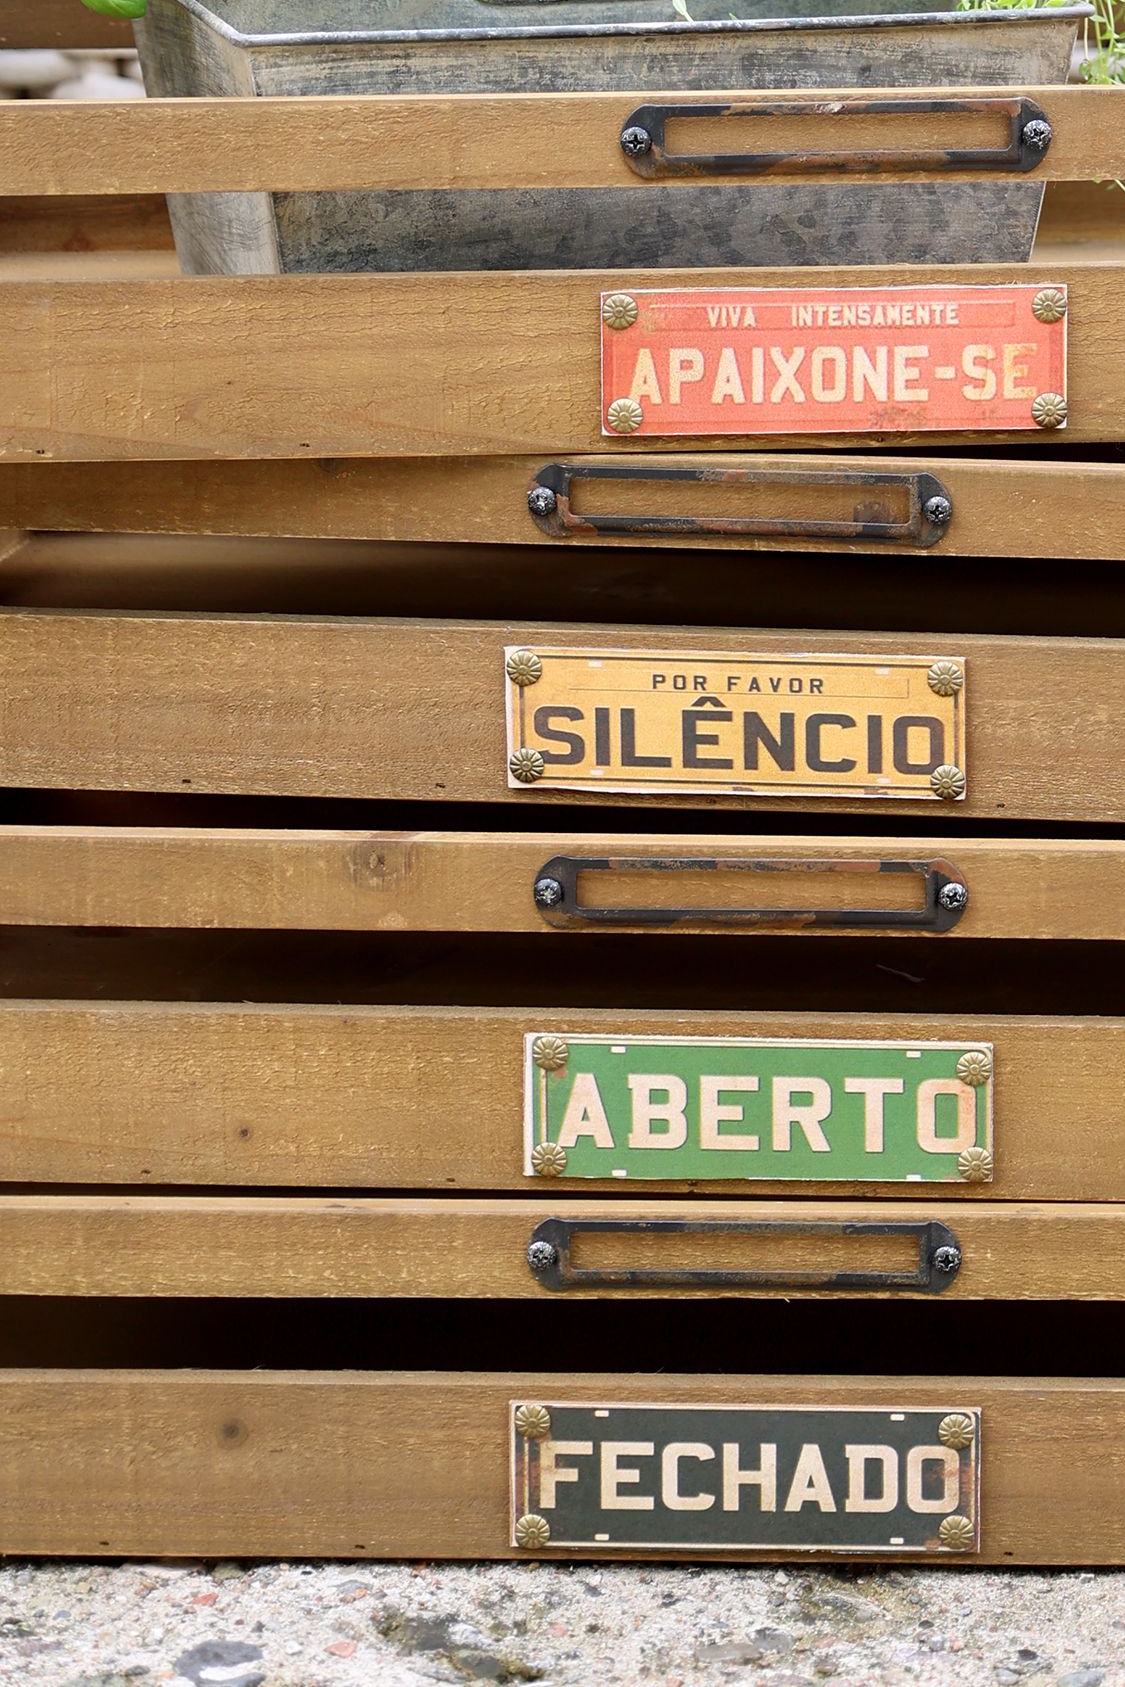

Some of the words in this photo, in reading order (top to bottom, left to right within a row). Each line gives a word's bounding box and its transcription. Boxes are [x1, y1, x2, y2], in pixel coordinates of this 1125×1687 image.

[705, 306, 756, 328] VIVA
[791, 302, 960, 328] INTENSAMENTE
[627, 343, 1038, 405] APAIXONE-SE
[652, 673, 708, 691] POR
[727, 675, 826, 694] FAVOR
[532, 696, 945, 776] SILÊNCIO
[558, 1072, 977, 1155] ABERTO
[538, 1440, 960, 1514] FECHADO
